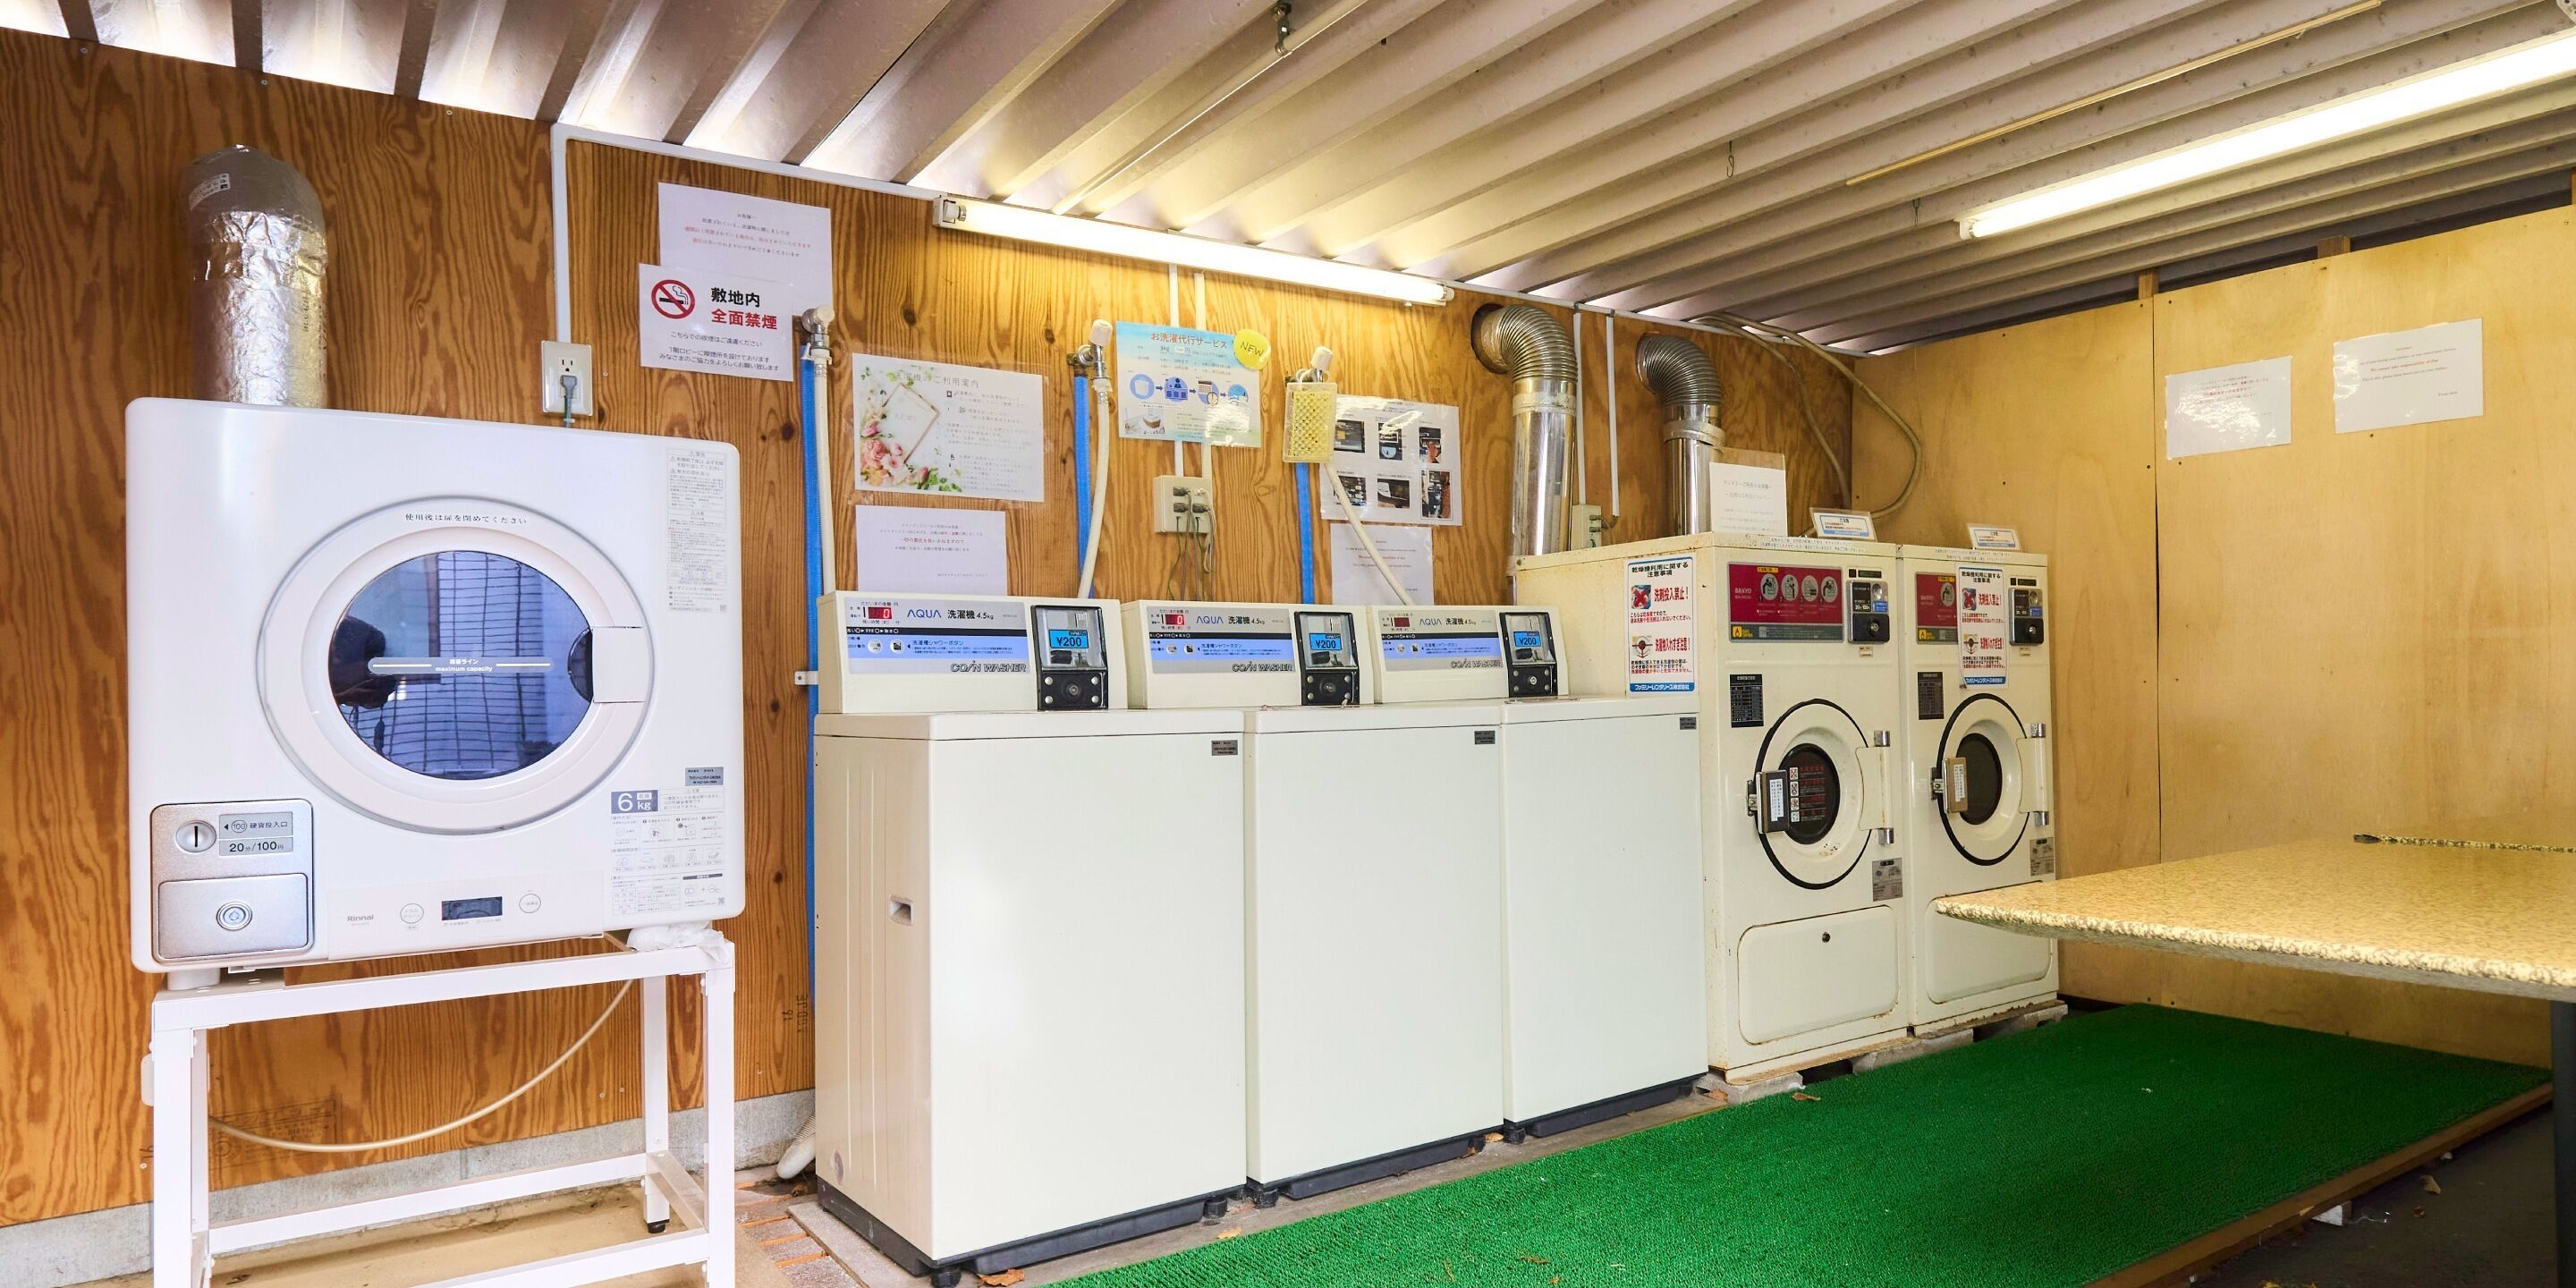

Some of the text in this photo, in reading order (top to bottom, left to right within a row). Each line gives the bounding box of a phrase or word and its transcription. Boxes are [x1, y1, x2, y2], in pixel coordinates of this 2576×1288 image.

[711, 287, 760, 308] 敷地内
[711, 309, 777, 330] 全面禁煙
[671, 331, 762, 347] こちらでの喫煙はご遠慮ください
[1151, 332, 1228, 350] お洗濯代行サービス
[1239, 341, 1266, 357] NEW
[659, 353, 779, 371] みなさまのご協力をよろしくお願い致します
[405, 513, 527, 524] 使用後は扉を閉めてください
[1631, 562, 1689, 573] 乾燥機利用に関する
[1647, 570, 1673, 578] 注意事項
[1962, 571, 2001, 580] 乾燥機利用に関する
[883, 609, 890, 619] 0
[907, 608, 942, 619] AQUA
[947, 609, 994, 620] 洗濯機 4.5kg
[1177, 616, 1183, 625] 0
[1196, 615, 1224, 624] AQUA
[1228, 615, 1266, 625] 洗濯機 4.5kg
[1419, 618, 1443, 626] AQUA
[1445, 617, 1464, 625] 洗濯機
[1056, 636, 1082, 647] ¥200
[1316, 640, 1336, 649] ¥200
[1519, 637, 1537, 646] ¥200
[951, 660, 1027, 673] COIN WASHER
[1232, 661, 1293, 672] COIN WASHER
[618, 792, 651, 812] 6 kg
[250, 821, 288, 829] 硬貨投入口
[347, 913, 374, 922] Rinnai
